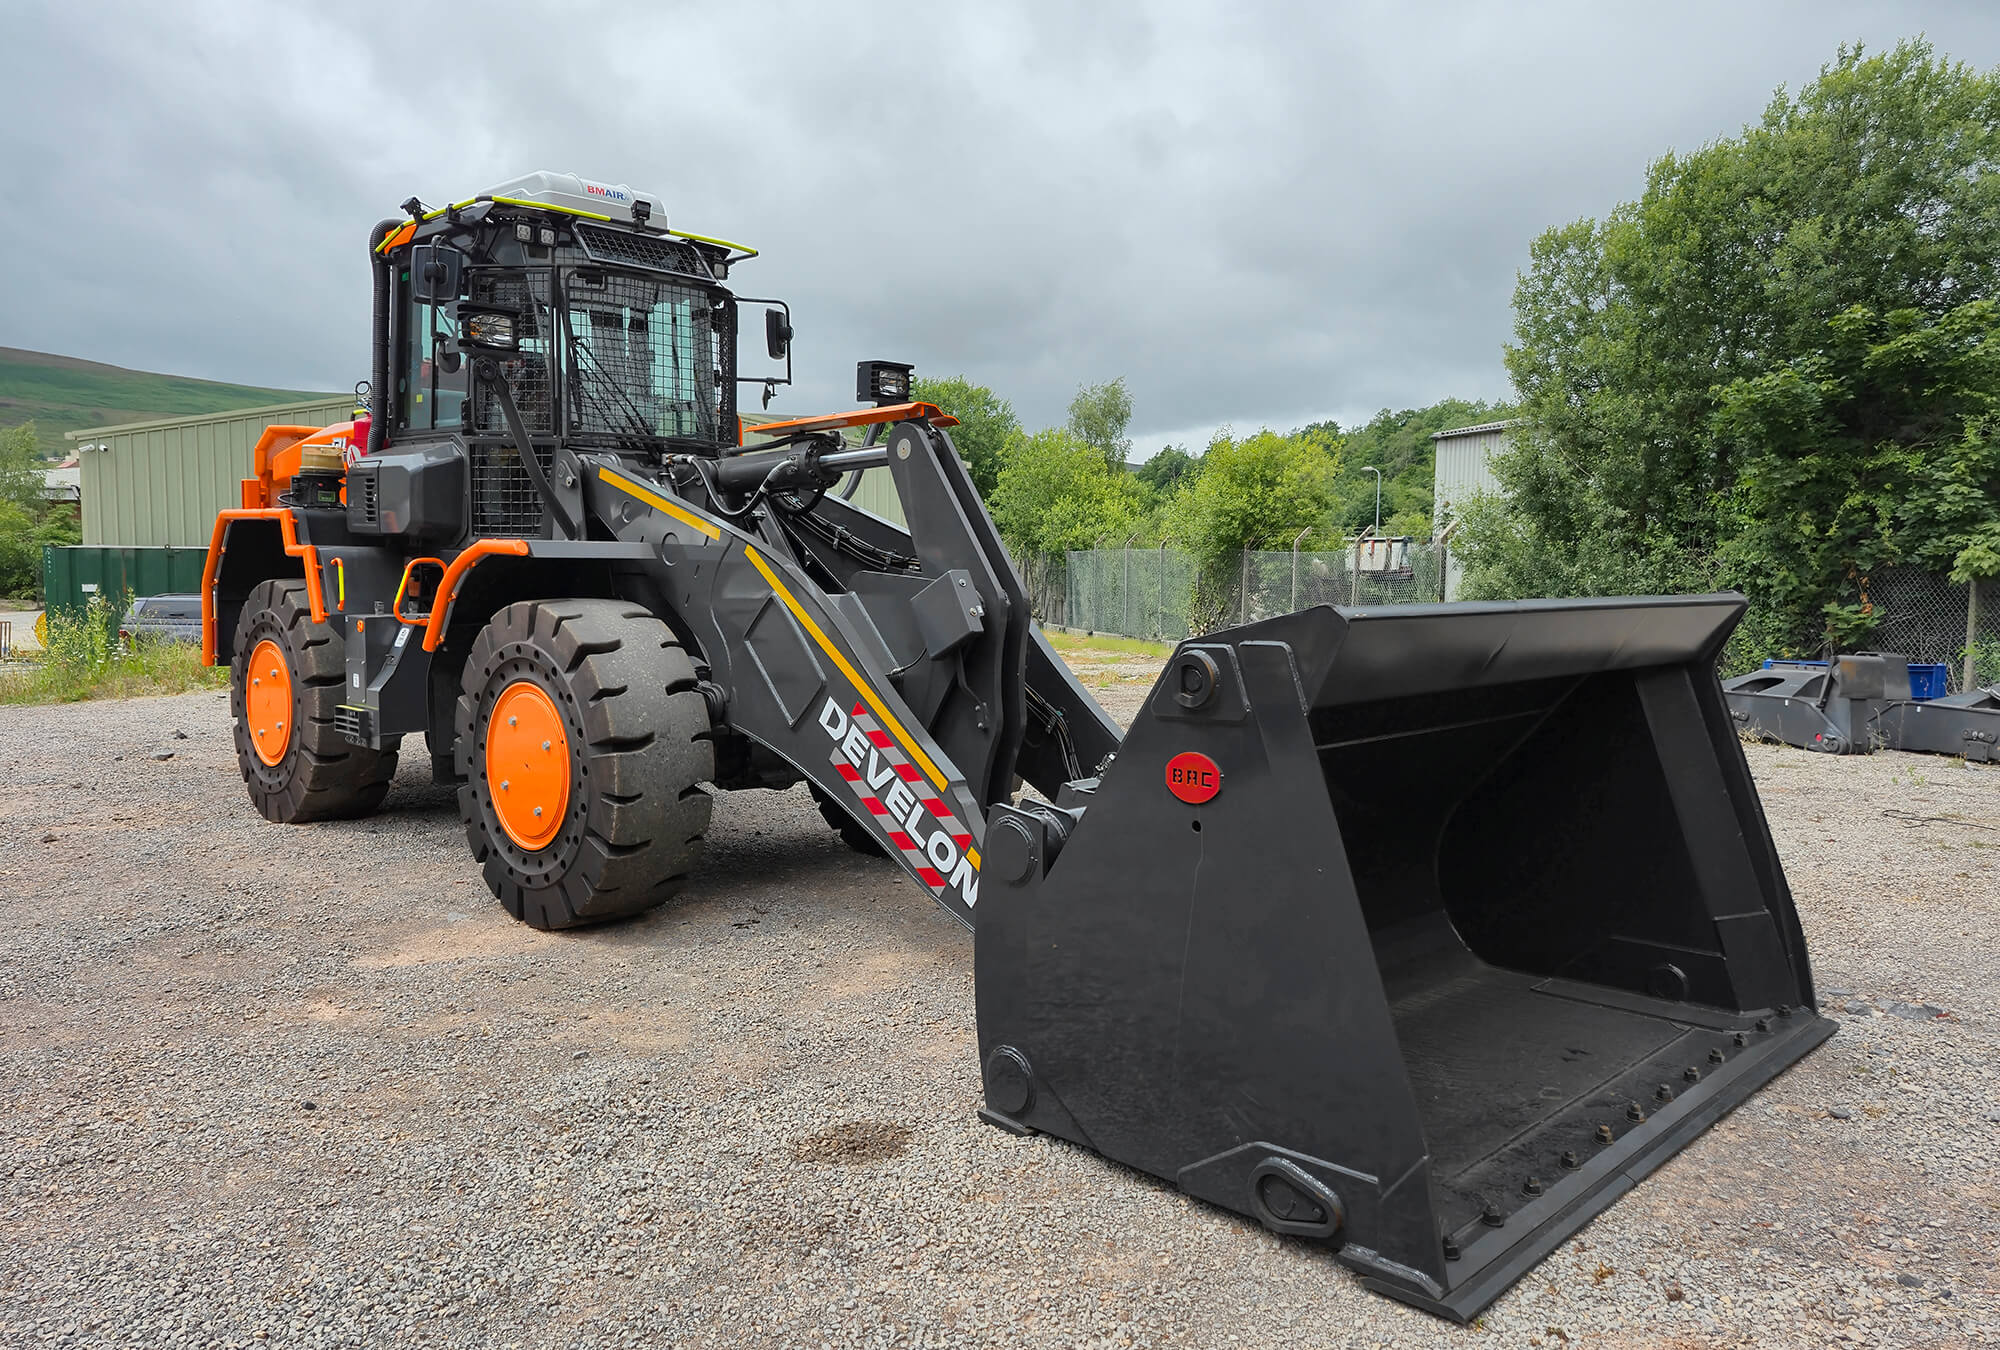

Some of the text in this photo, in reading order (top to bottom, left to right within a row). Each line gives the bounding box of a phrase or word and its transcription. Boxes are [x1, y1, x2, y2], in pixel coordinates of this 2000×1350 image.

[587, 185, 625, 200] BMAIR
[1172, 767, 1213, 788] BAC
[818, 695, 980, 909] DEVELON
